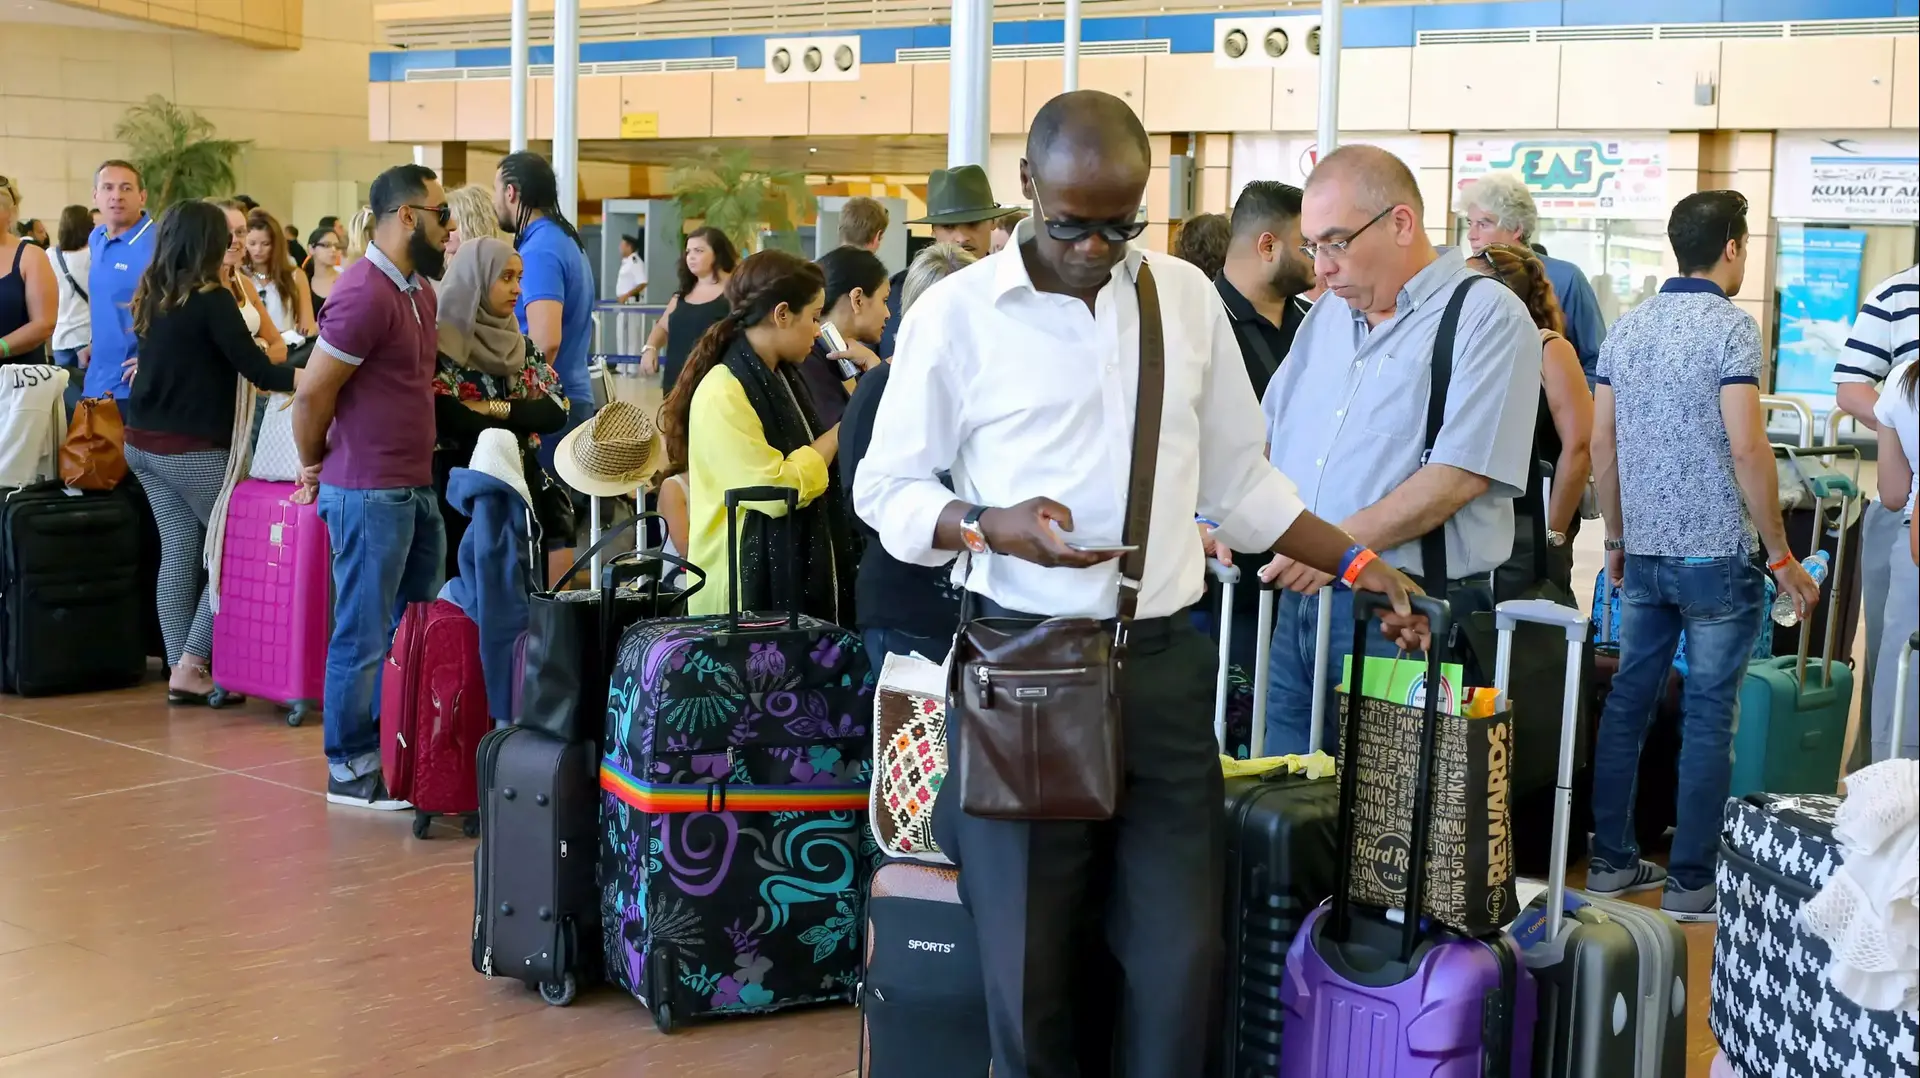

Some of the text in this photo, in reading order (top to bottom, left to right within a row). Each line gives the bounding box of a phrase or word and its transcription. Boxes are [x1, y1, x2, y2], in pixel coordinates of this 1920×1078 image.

[1522, 149, 1592, 190] EAS
[1811, 184, 1893, 197] KUWAIT
[1446, 770, 1467, 805] PARIS
[1486, 722, 1509, 887] REWARDS
[1434, 817, 1466, 835] MACAU
[1356, 837, 1394, 864] Hard
[1432, 839, 1466, 857] TOKYO
[1382, 871, 1403, 884] CAFE
[1489, 903, 1501, 924] Hard
[1527, 915, 1548, 934] Condo
